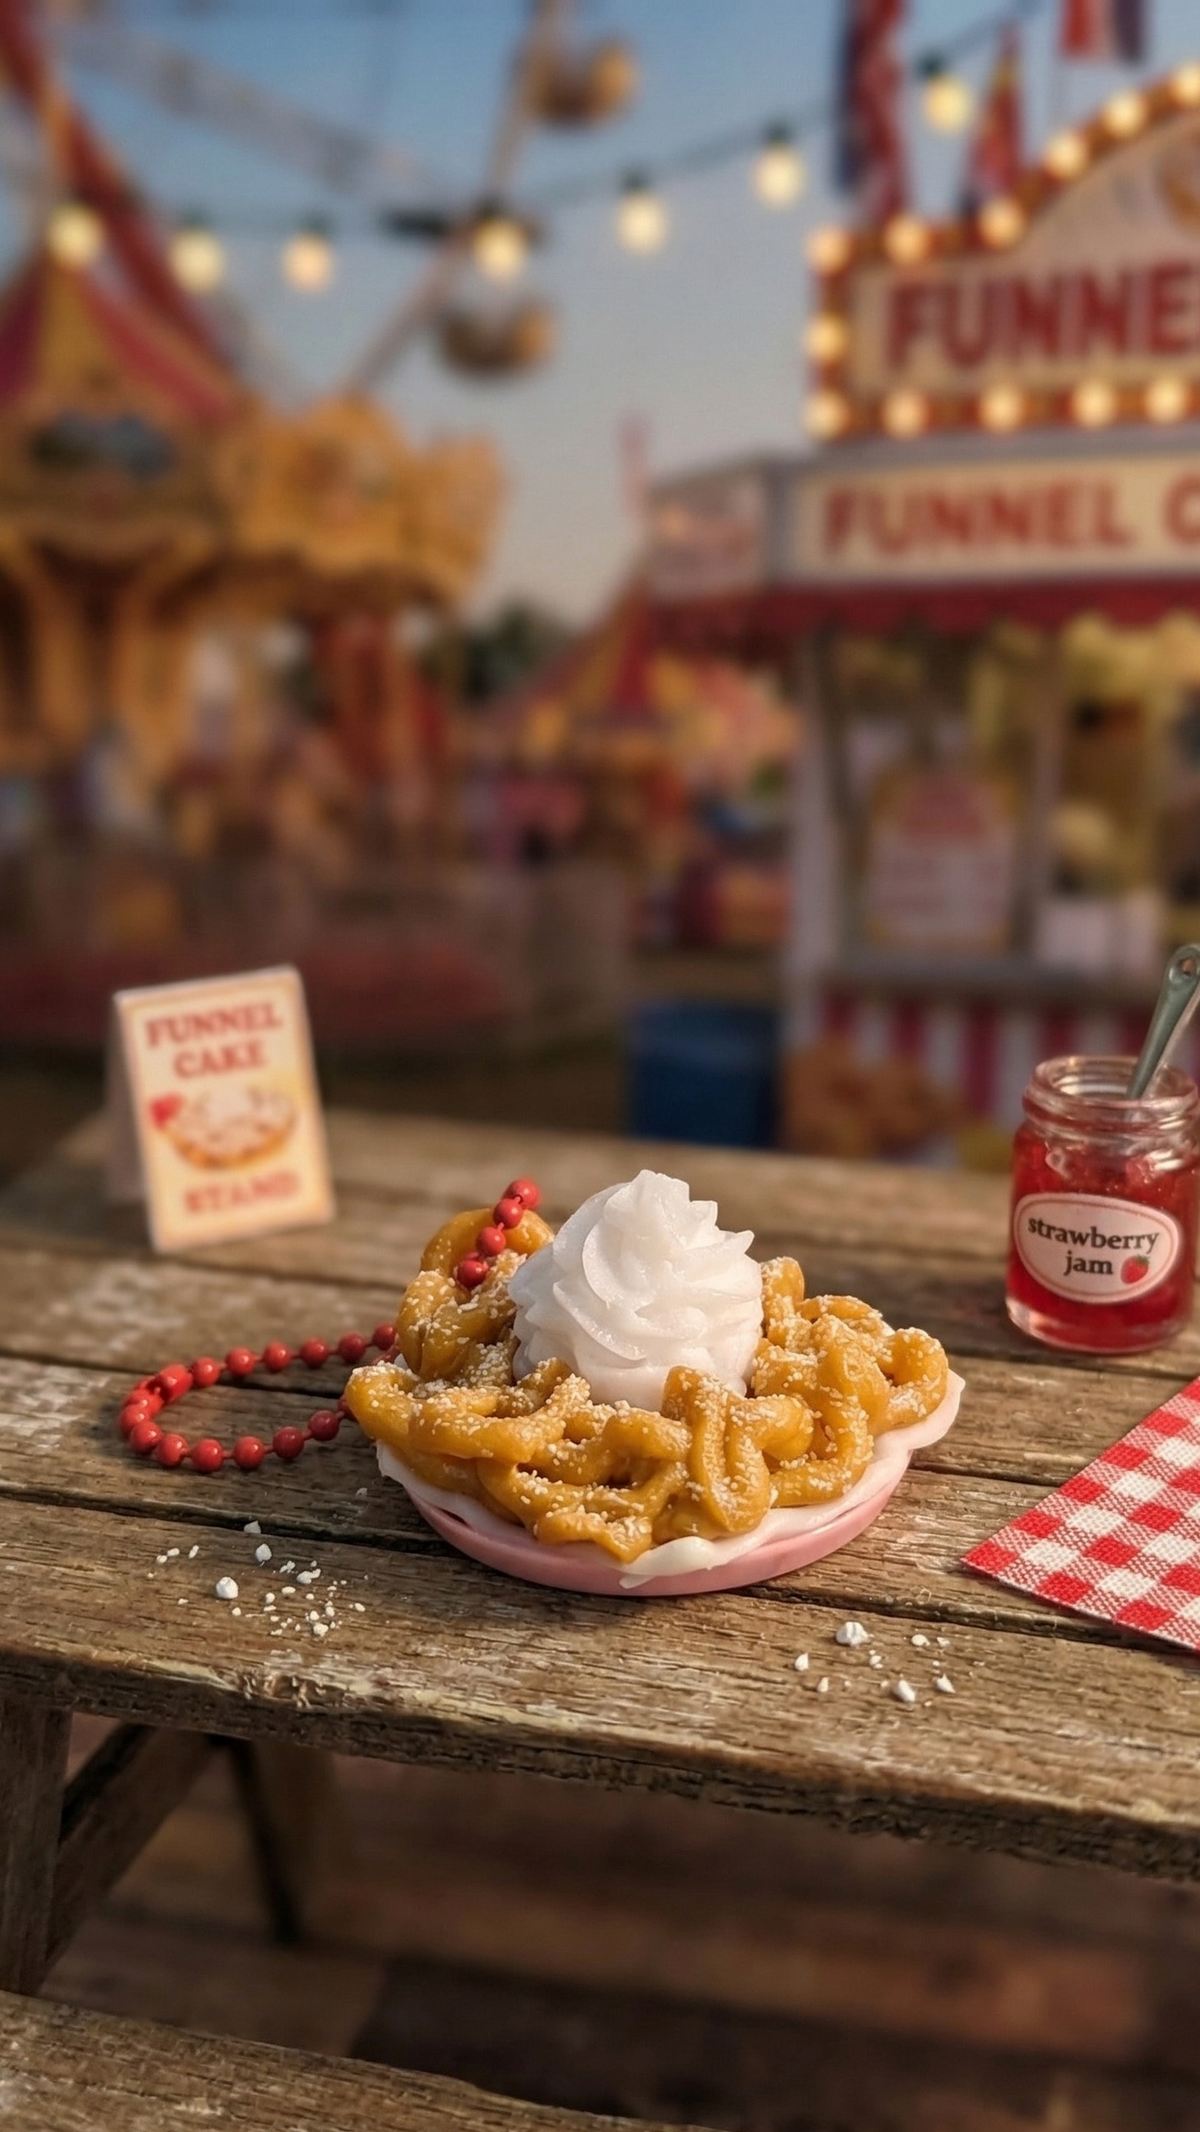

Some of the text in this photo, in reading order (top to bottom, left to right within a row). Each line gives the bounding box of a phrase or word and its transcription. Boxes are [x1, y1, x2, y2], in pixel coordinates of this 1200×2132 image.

[824, 477, 1132, 556] FUNNEL
[145, 1002, 283, 1050] FUNNEL
[172, 1040, 268, 1081] CAKE
[1027, 1217, 1161, 1254] strawberry
[1062, 1250, 1114, 1277] jam
